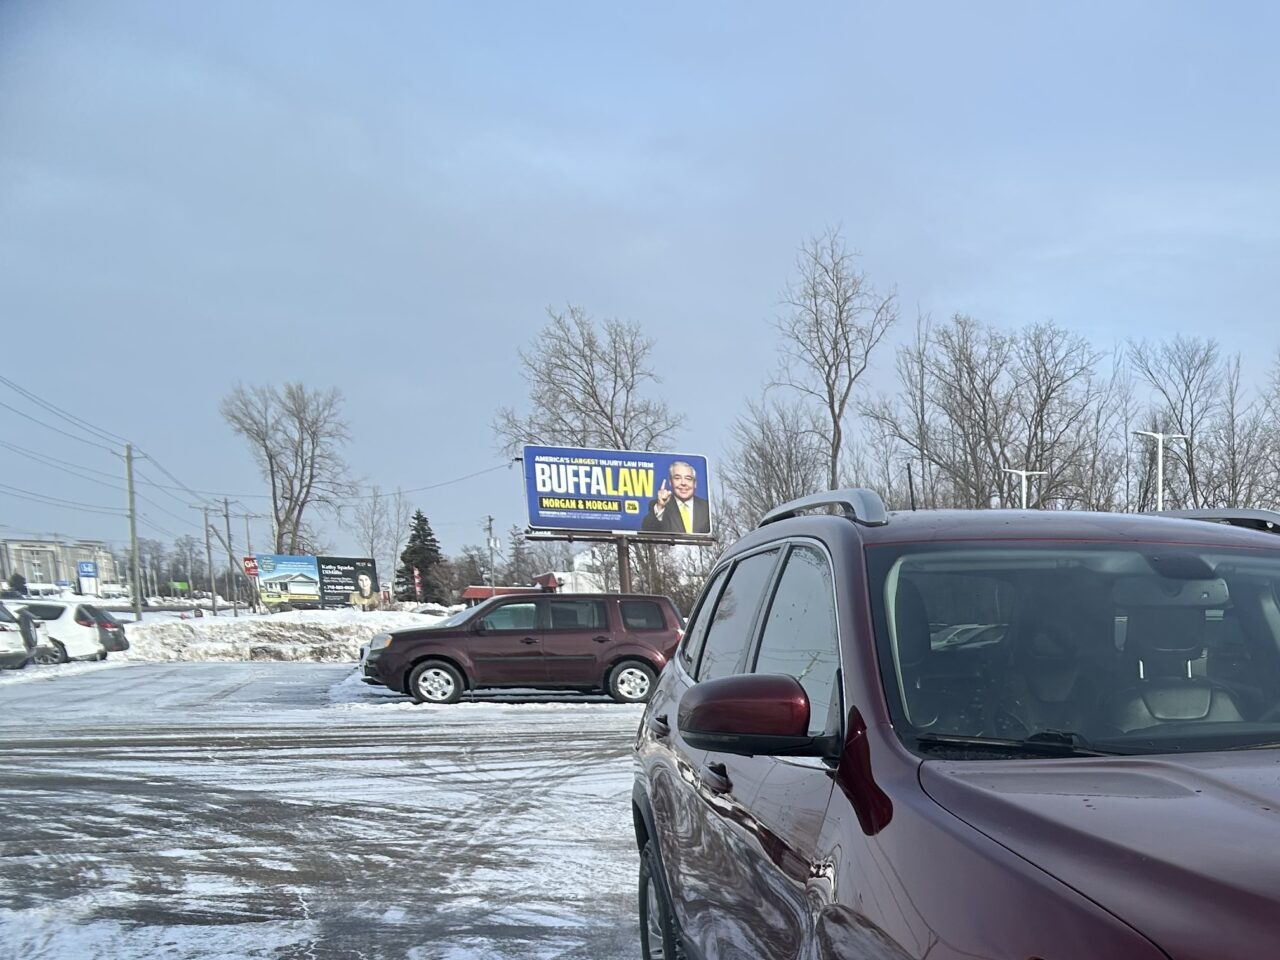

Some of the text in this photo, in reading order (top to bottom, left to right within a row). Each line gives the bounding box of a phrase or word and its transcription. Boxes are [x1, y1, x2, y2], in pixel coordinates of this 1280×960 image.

[535, 455, 570, 463] AMERICA'S
[534, 463, 654, 498] BUFFALAW
[542, 498, 577, 509] MORGAN
[578, 500, 584, 509] &
[585, 501, 619, 511] MORGAN
